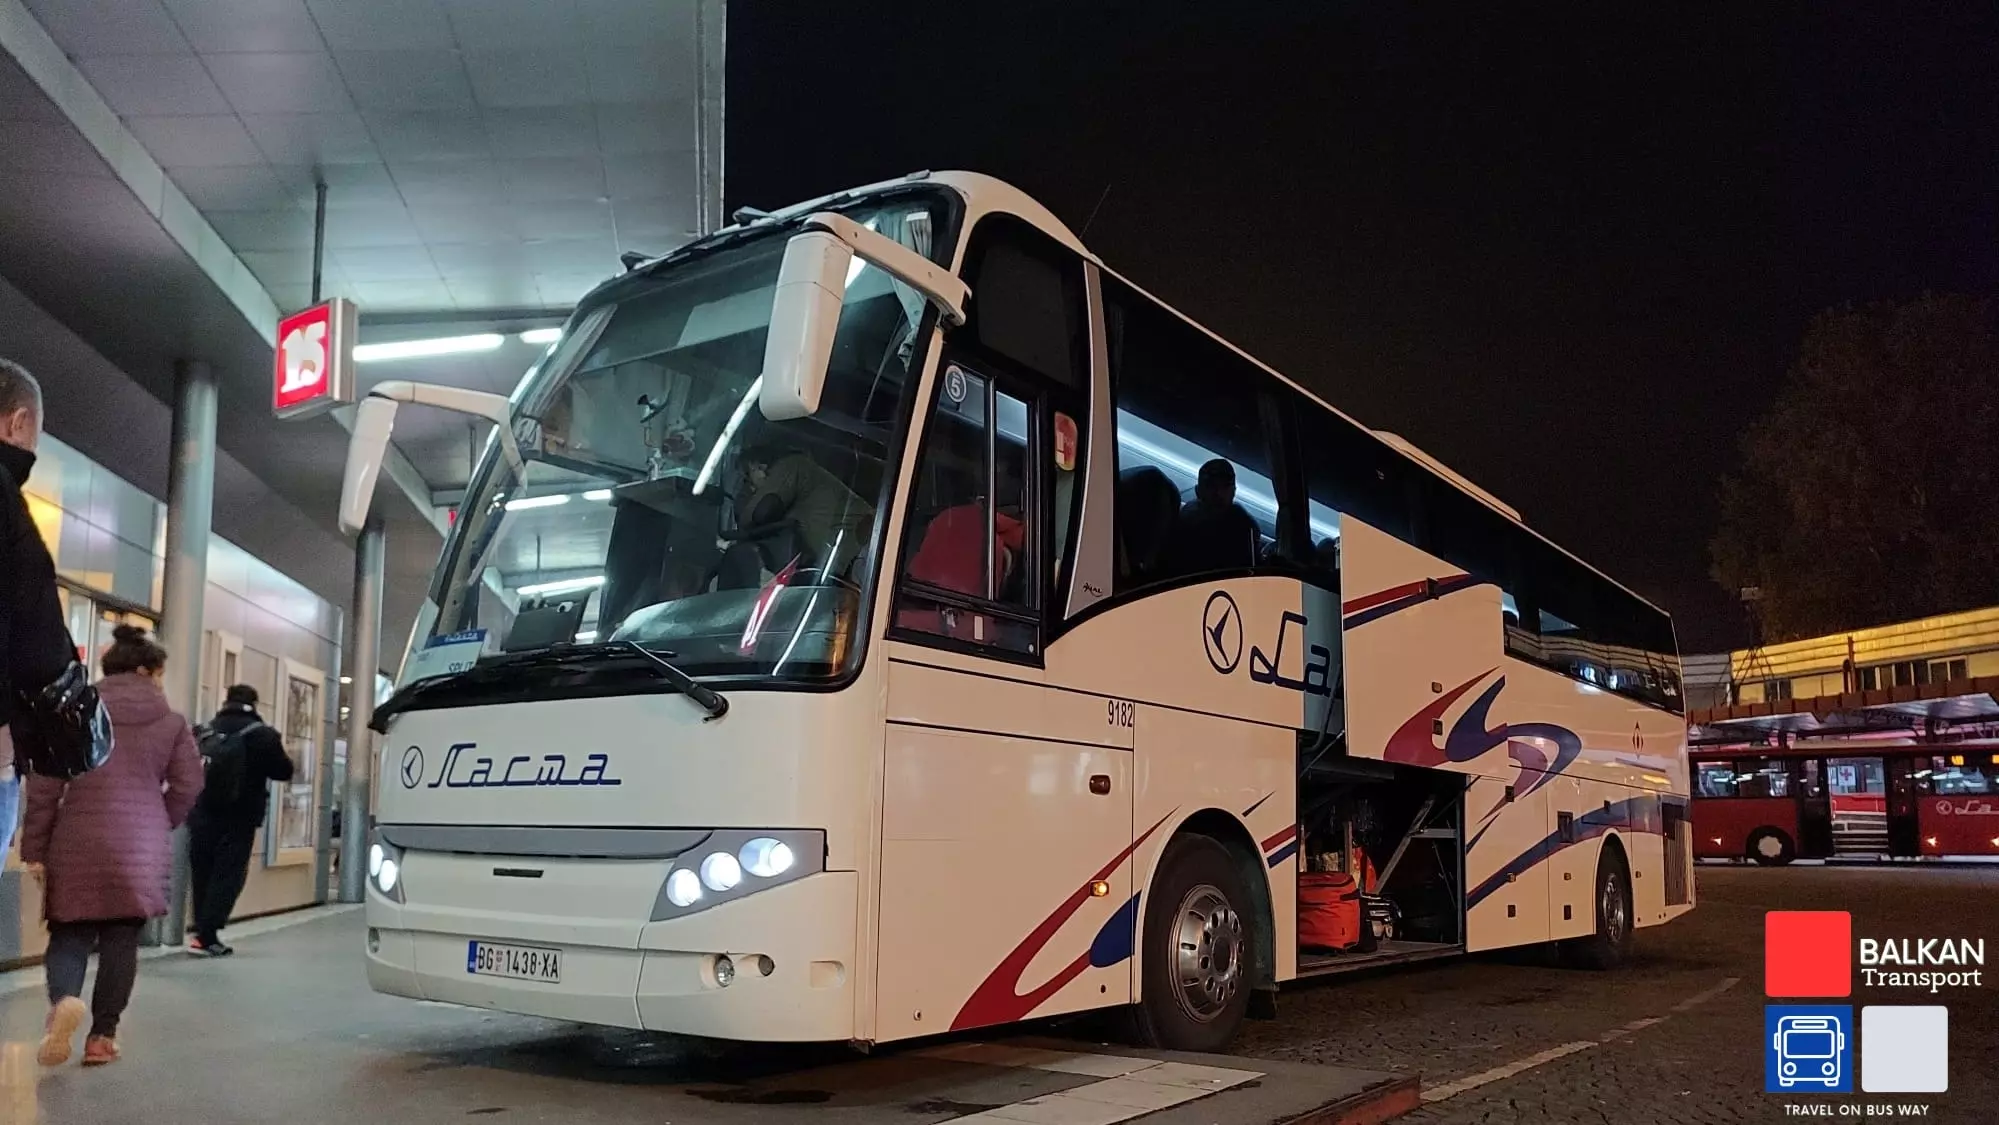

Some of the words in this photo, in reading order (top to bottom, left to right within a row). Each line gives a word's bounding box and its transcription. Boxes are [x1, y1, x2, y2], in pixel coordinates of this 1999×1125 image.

[281, 320, 326, 393] 15
[950, 377, 961, 398] 5
[1108, 699, 1133, 728] 9182
[477, 946, 494, 970] BG
